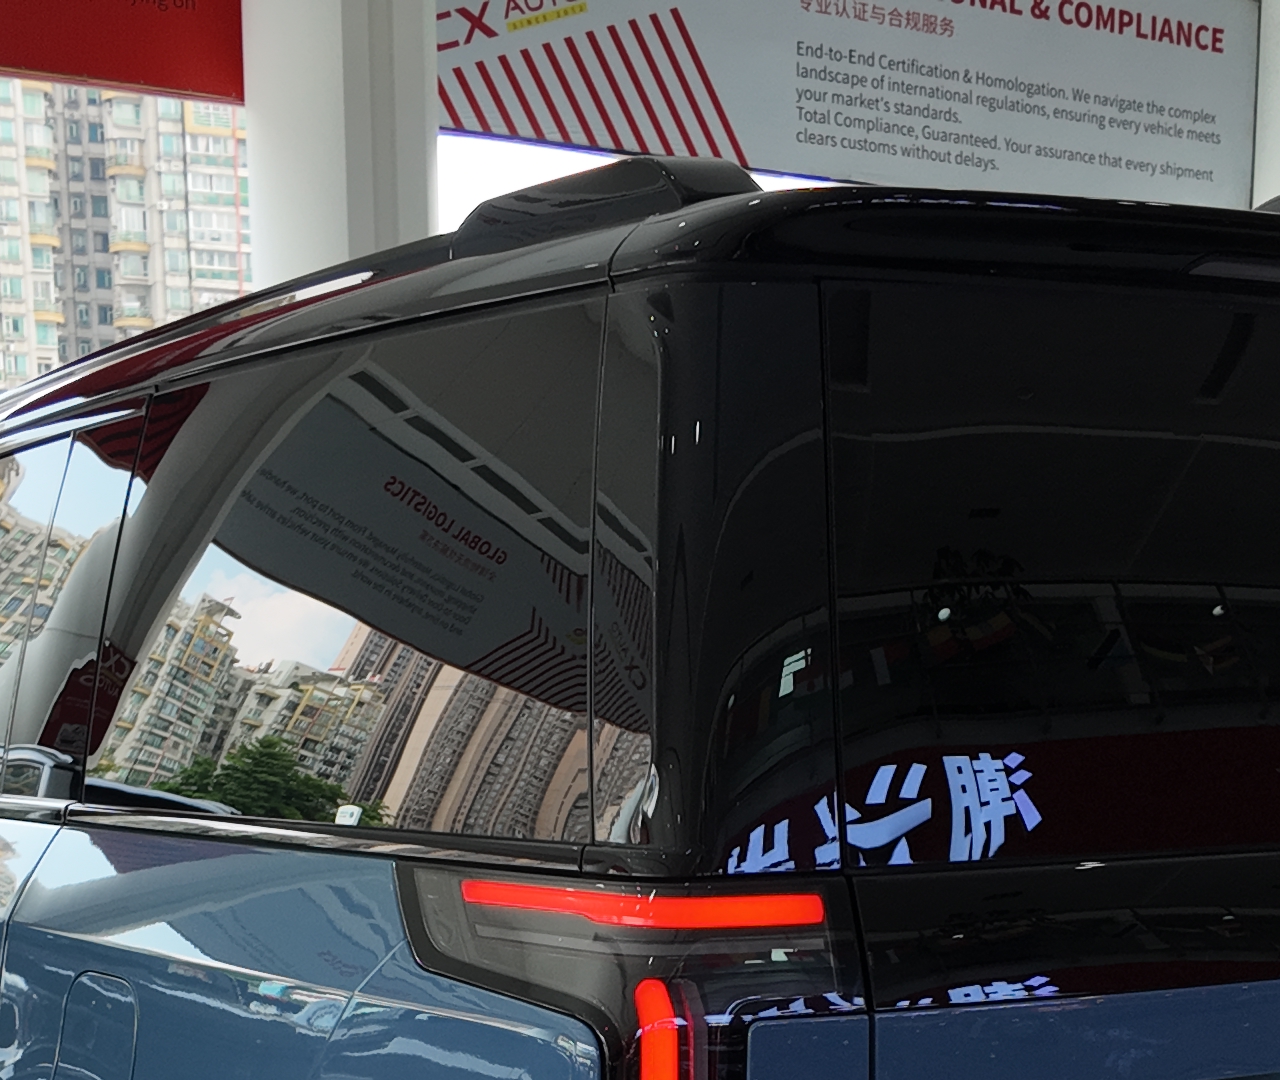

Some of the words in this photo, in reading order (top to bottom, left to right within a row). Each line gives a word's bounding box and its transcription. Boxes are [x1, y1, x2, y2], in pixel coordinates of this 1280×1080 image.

[800, 0, 955, 38] 专业认证与合规服务
[1030, 0, 1051, 20] &
[1057, 1, 1225, 54] COMPLIANCE
[795, 87, 828, 104] your
[831, 92, 891, 113] market's
[893, 99, 963, 124] standards.
[796, 40, 876, 67] End-to-End
[878, 53, 960, 82] Certification
[962, 69, 973, 84] &
[975, 71, 1069, 101] Homologation.
[1072, 87, 1091, 104] We
[1094, 94, 1144, 114] navigate
[1146, 100, 1166, 117] the
[1168, 106, 1217, 126] complex
[796, 62, 868, 90] landscape
[871, 75, 885, 90] of
[887, 76, 973, 105] international
[975, 94, 1051, 121] regulations,
[1053, 106, 1106, 131] ensuring
[1108, 117, 1141, 135] every
[1143, 119, 1184, 139] vehicle
[1186, 128, 1222, 145] meets
[795, 128, 837, 148] clears
[840, 136, 898, 156] customs
[900, 143, 953, 164] without
[955, 151, 1000, 172] delays.
[796, 105, 831, 125] Total
[833, 111, 919, 141] Compliance,
[921, 125, 1002, 151] Guaranteed.
[1004, 137, 1032, 155] Your
[1035, 144, 1096, 165] assurance
[1098, 152, 1123, 169] that
[1125, 159, 1157, 177] every
[1159, 163, 1214, 183] shipment
